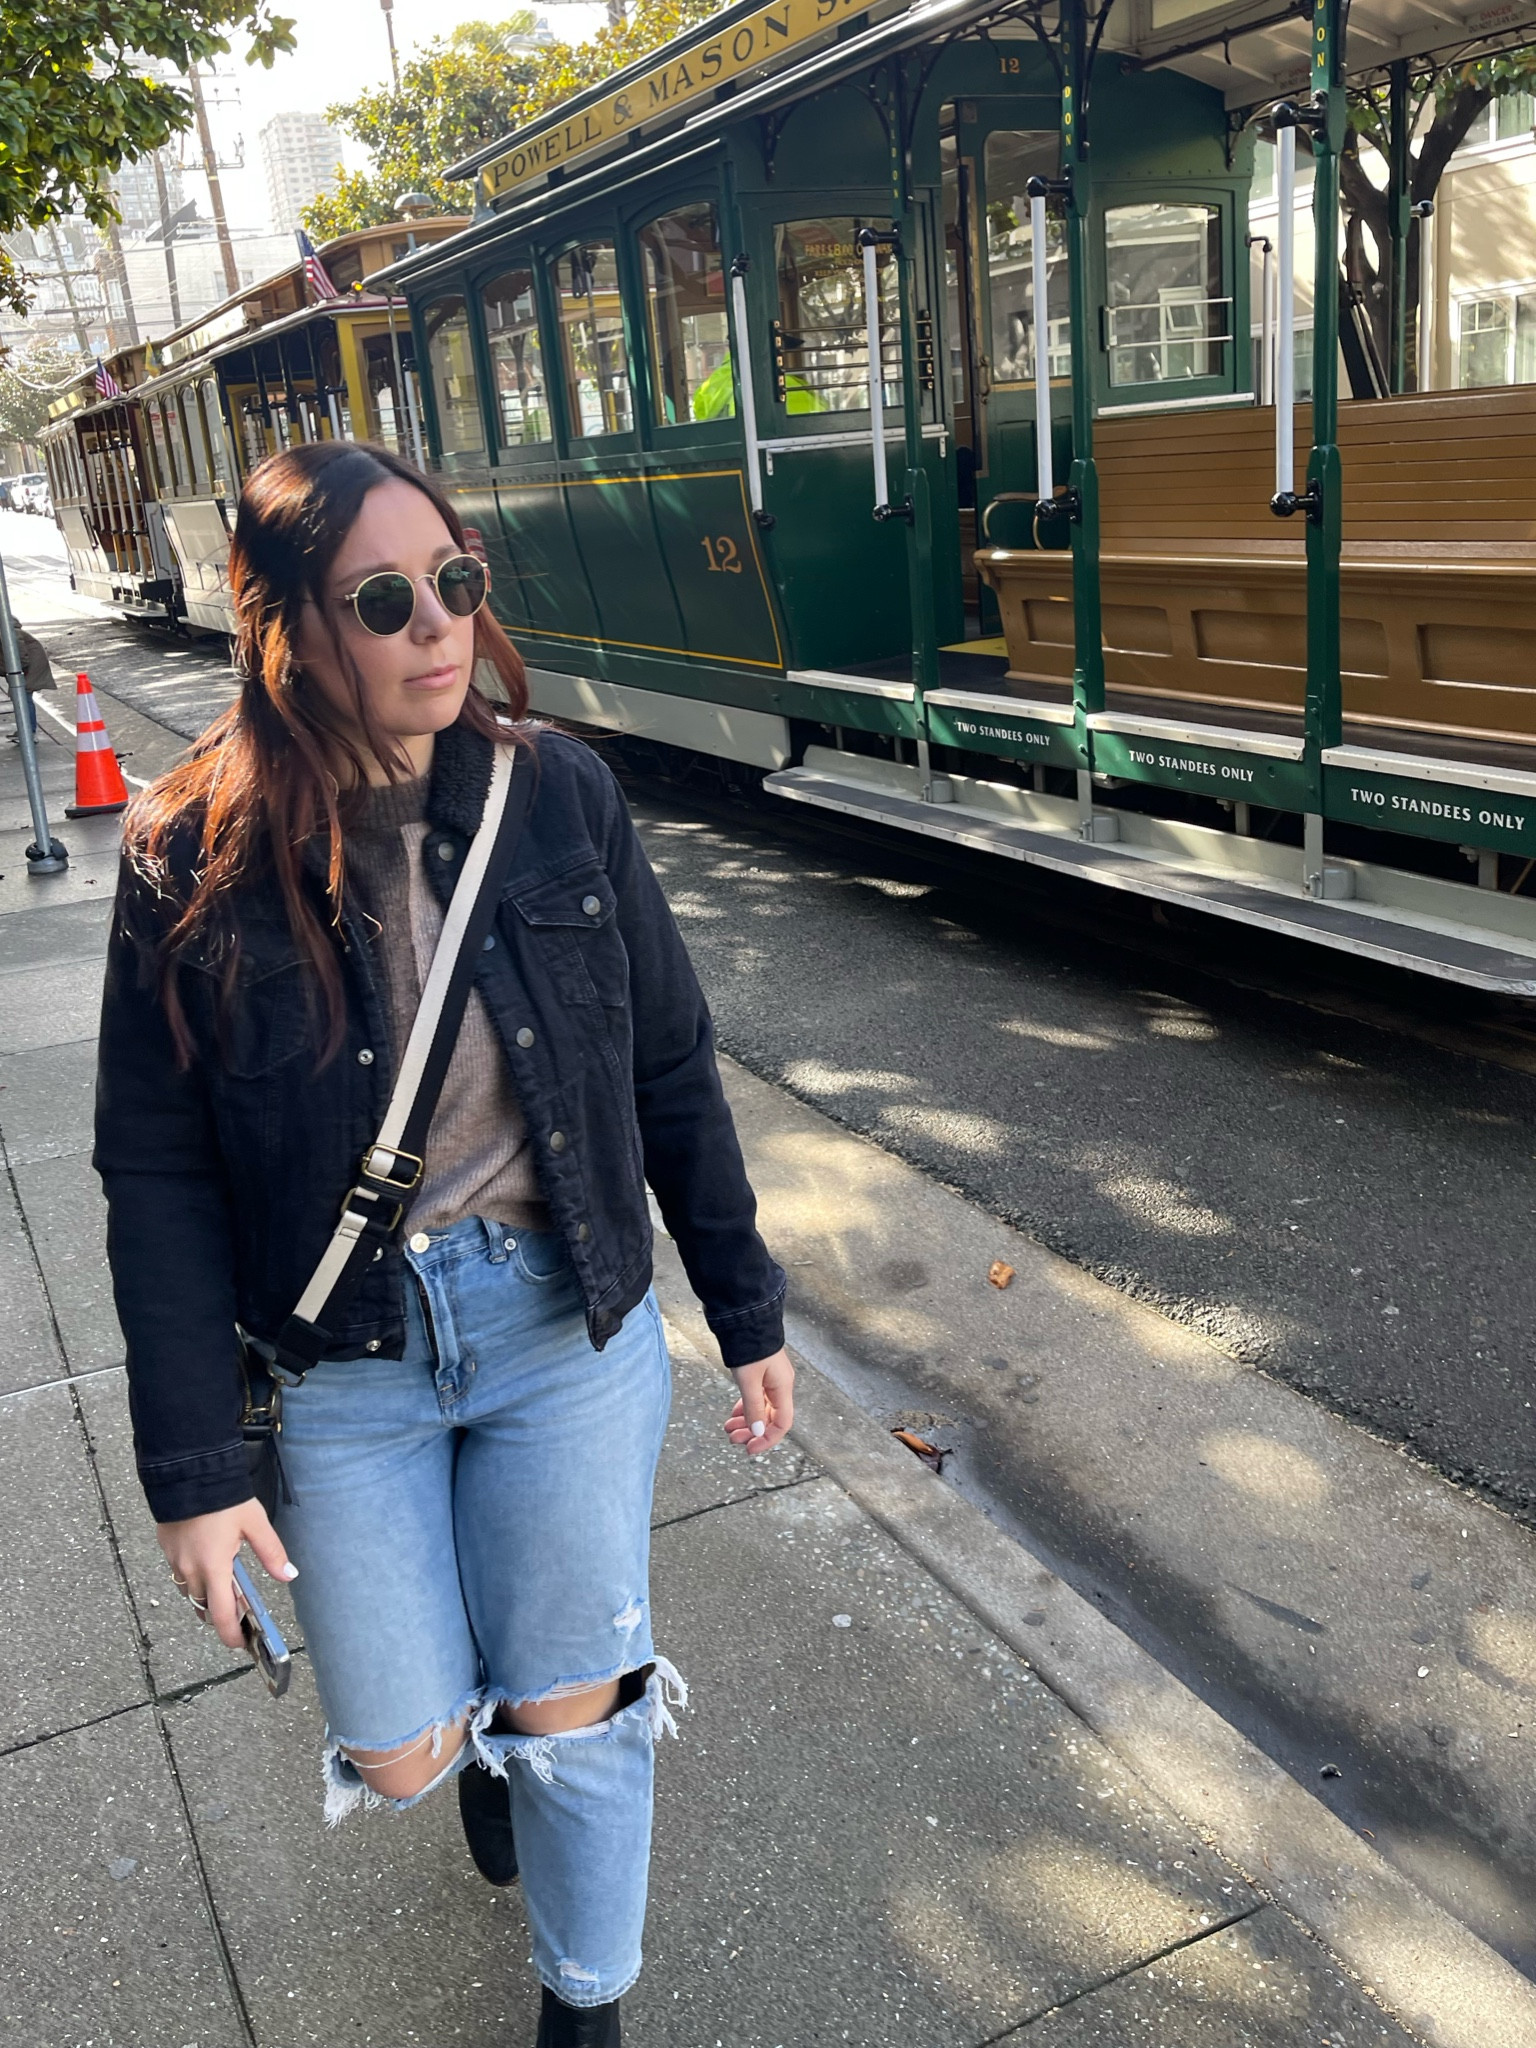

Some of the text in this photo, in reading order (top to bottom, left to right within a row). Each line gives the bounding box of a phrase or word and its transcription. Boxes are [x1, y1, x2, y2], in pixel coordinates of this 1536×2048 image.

[1000, 57, 1020, 74] 12
[493, 116, 602, 188] POWELL
[613, 94, 633, 126] &
[648, 5, 791, 107] MASON
[701, 536, 742, 573] 12
[957, 721, 1050, 746] TWO STANDEES ONLY
[1129, 750, 1254, 782] TWO STANDEES ONLY
[1350, 788, 1525, 831] TWO STANDEES ONLY
